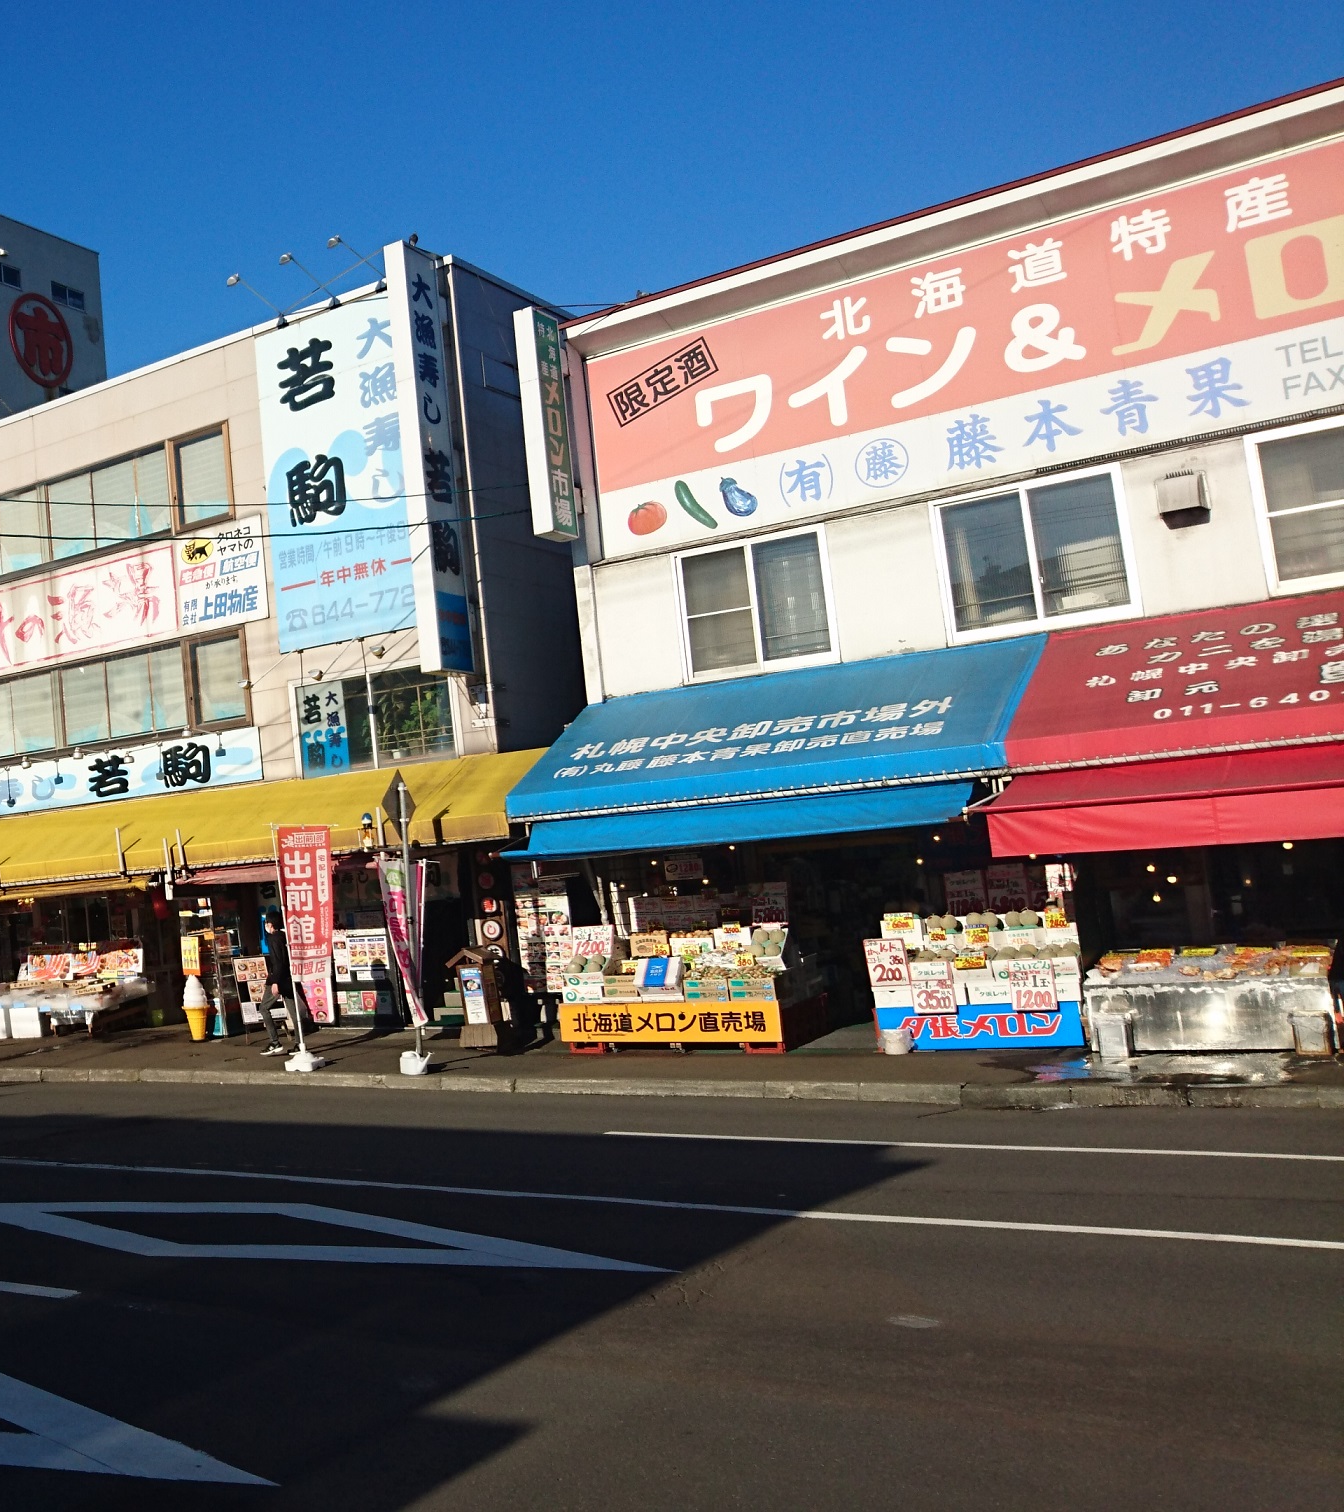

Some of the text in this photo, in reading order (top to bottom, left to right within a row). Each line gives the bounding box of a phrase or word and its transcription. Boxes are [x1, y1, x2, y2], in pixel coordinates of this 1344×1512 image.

[819, 173, 1293, 341] 北海道特産
[16, 307, 64, 376] 市
[412, 273, 442, 426] 大漁寿し
[1275, 335, 1344, 368] TEL
[355, 317, 404, 503] 大漁寿し
[613, 344, 711, 421] 限定酒
[276, 337, 347, 528] 若駒
[946, 357, 1251, 475] 藤本青果
[544, 381, 573, 528] メロン市場
[424, 449, 462, 578] 若駒
[217, 538, 254, 556] ヤマトの
[320, 557, 387, 588] 年中無休
[198, 585, 259, 622] 上田物産
[569, 696, 953, 761] 札幌中央卸売市場外
[647, 721, 946, 769] 藤本青果卸売直売場
[87, 743, 212, 798] 若駒
[283, 850, 316, 945] 出前館
[292, 960, 327, 977] 加盟店
[1016, 989, 1053, 1009] 1200
[572, 1010, 767, 1034] 北海道メロン直売場
[896, 1012, 1063, 1040] 夕張メロン
